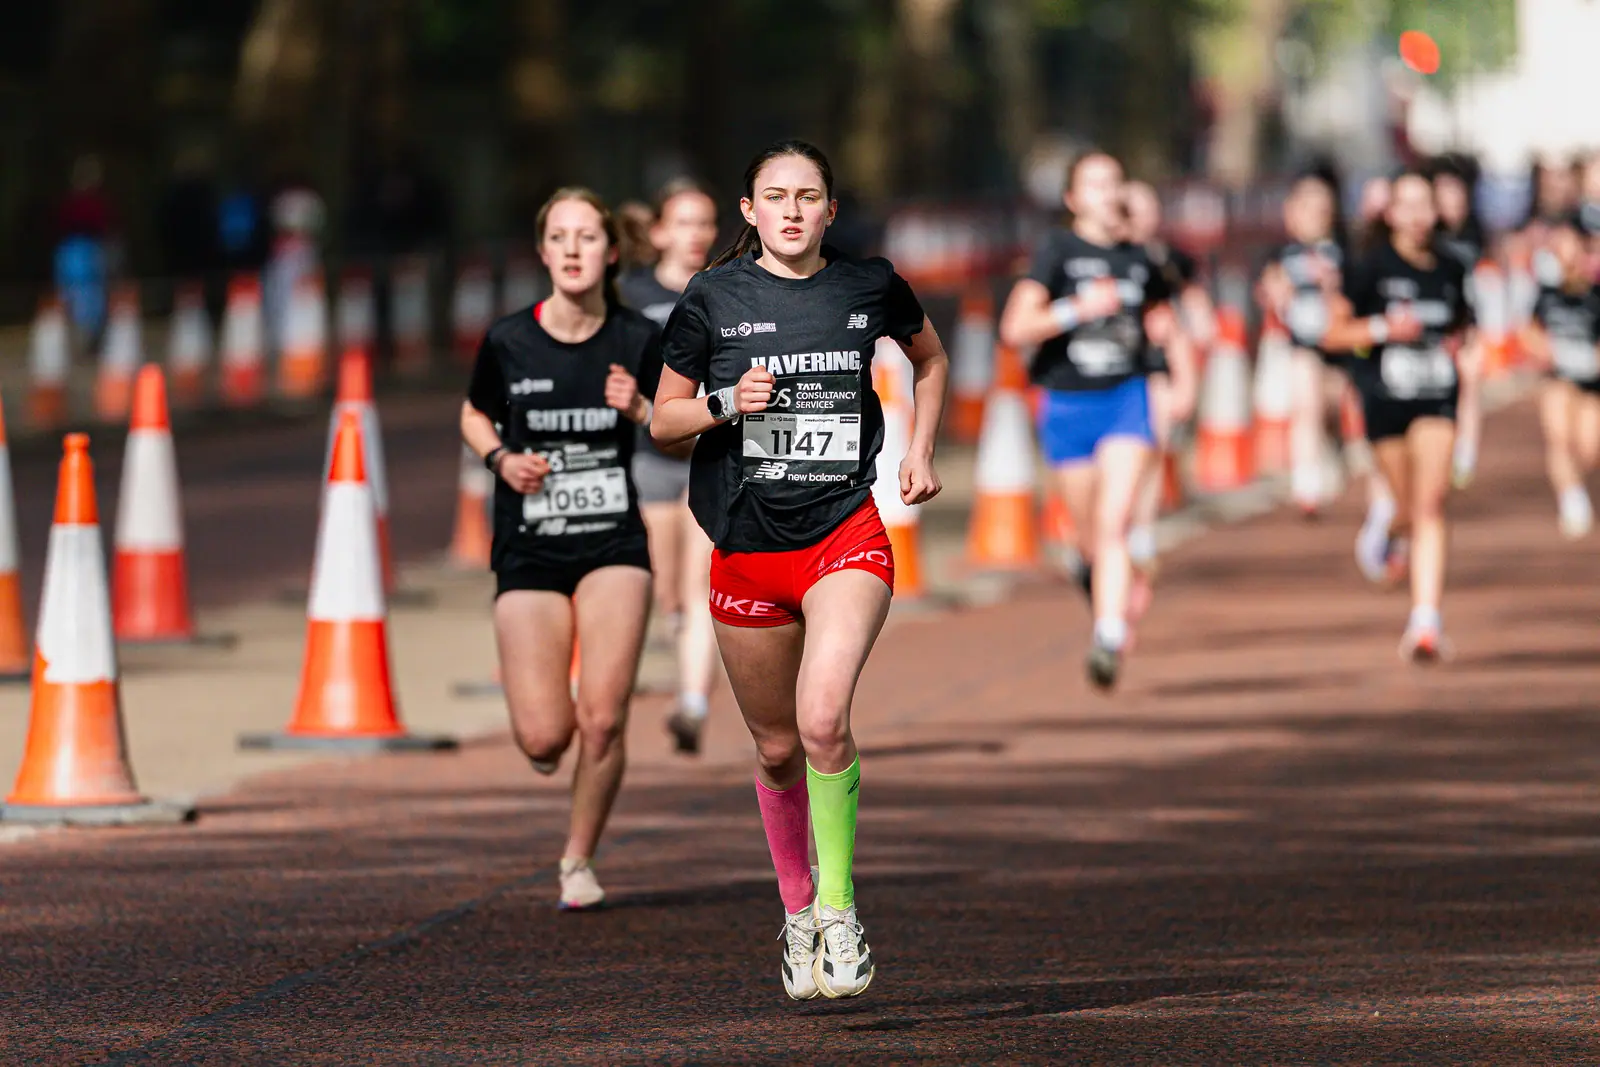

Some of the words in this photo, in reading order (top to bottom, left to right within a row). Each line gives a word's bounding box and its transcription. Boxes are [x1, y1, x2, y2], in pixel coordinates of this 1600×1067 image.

[721, 327, 737, 338] tcs
[751, 350, 861, 376] HAVERING
[796, 392, 857, 400] CONSULTANCY
[796, 401, 834, 409] SERVICES
[526, 408, 618, 432] SUTTON
[771, 429, 834, 456] 1147
[788, 474, 809, 482] new
[809, 473, 848, 482] balance
[544, 487, 606, 512] 1063
